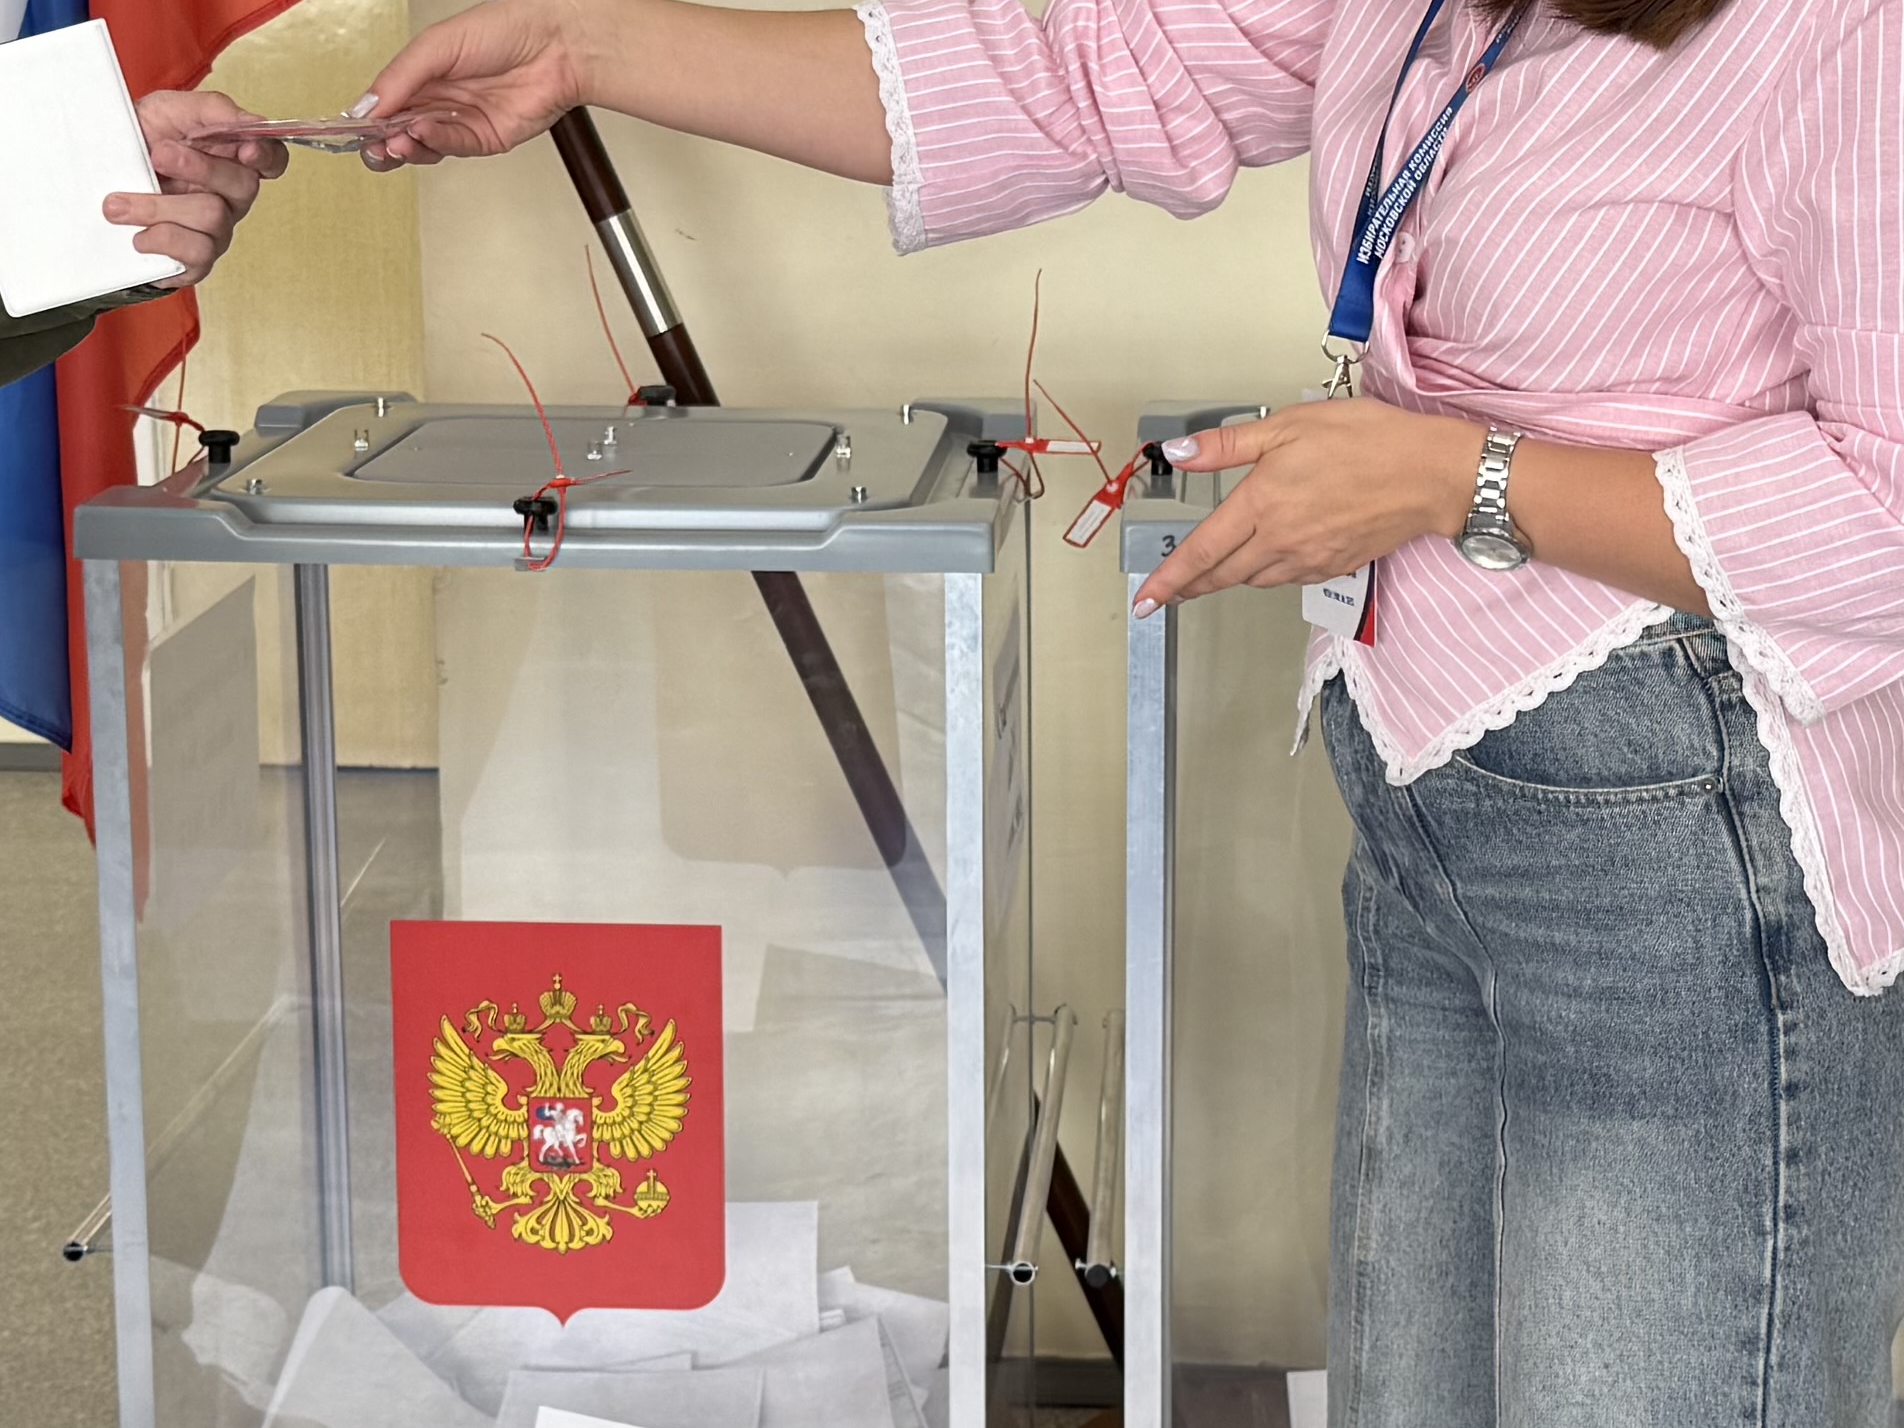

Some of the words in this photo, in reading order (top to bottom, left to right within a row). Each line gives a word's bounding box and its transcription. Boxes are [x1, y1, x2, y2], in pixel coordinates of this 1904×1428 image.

[1356, 170, 1411, 264] ИЗБИРАТЕЛЬНАЯ
[1408, 107, 1453, 171] КОМИССИЯ
[1374, 180, 1417, 259] МОСКОВСКОЙ
[1161, 535, 1176, 557] 3
